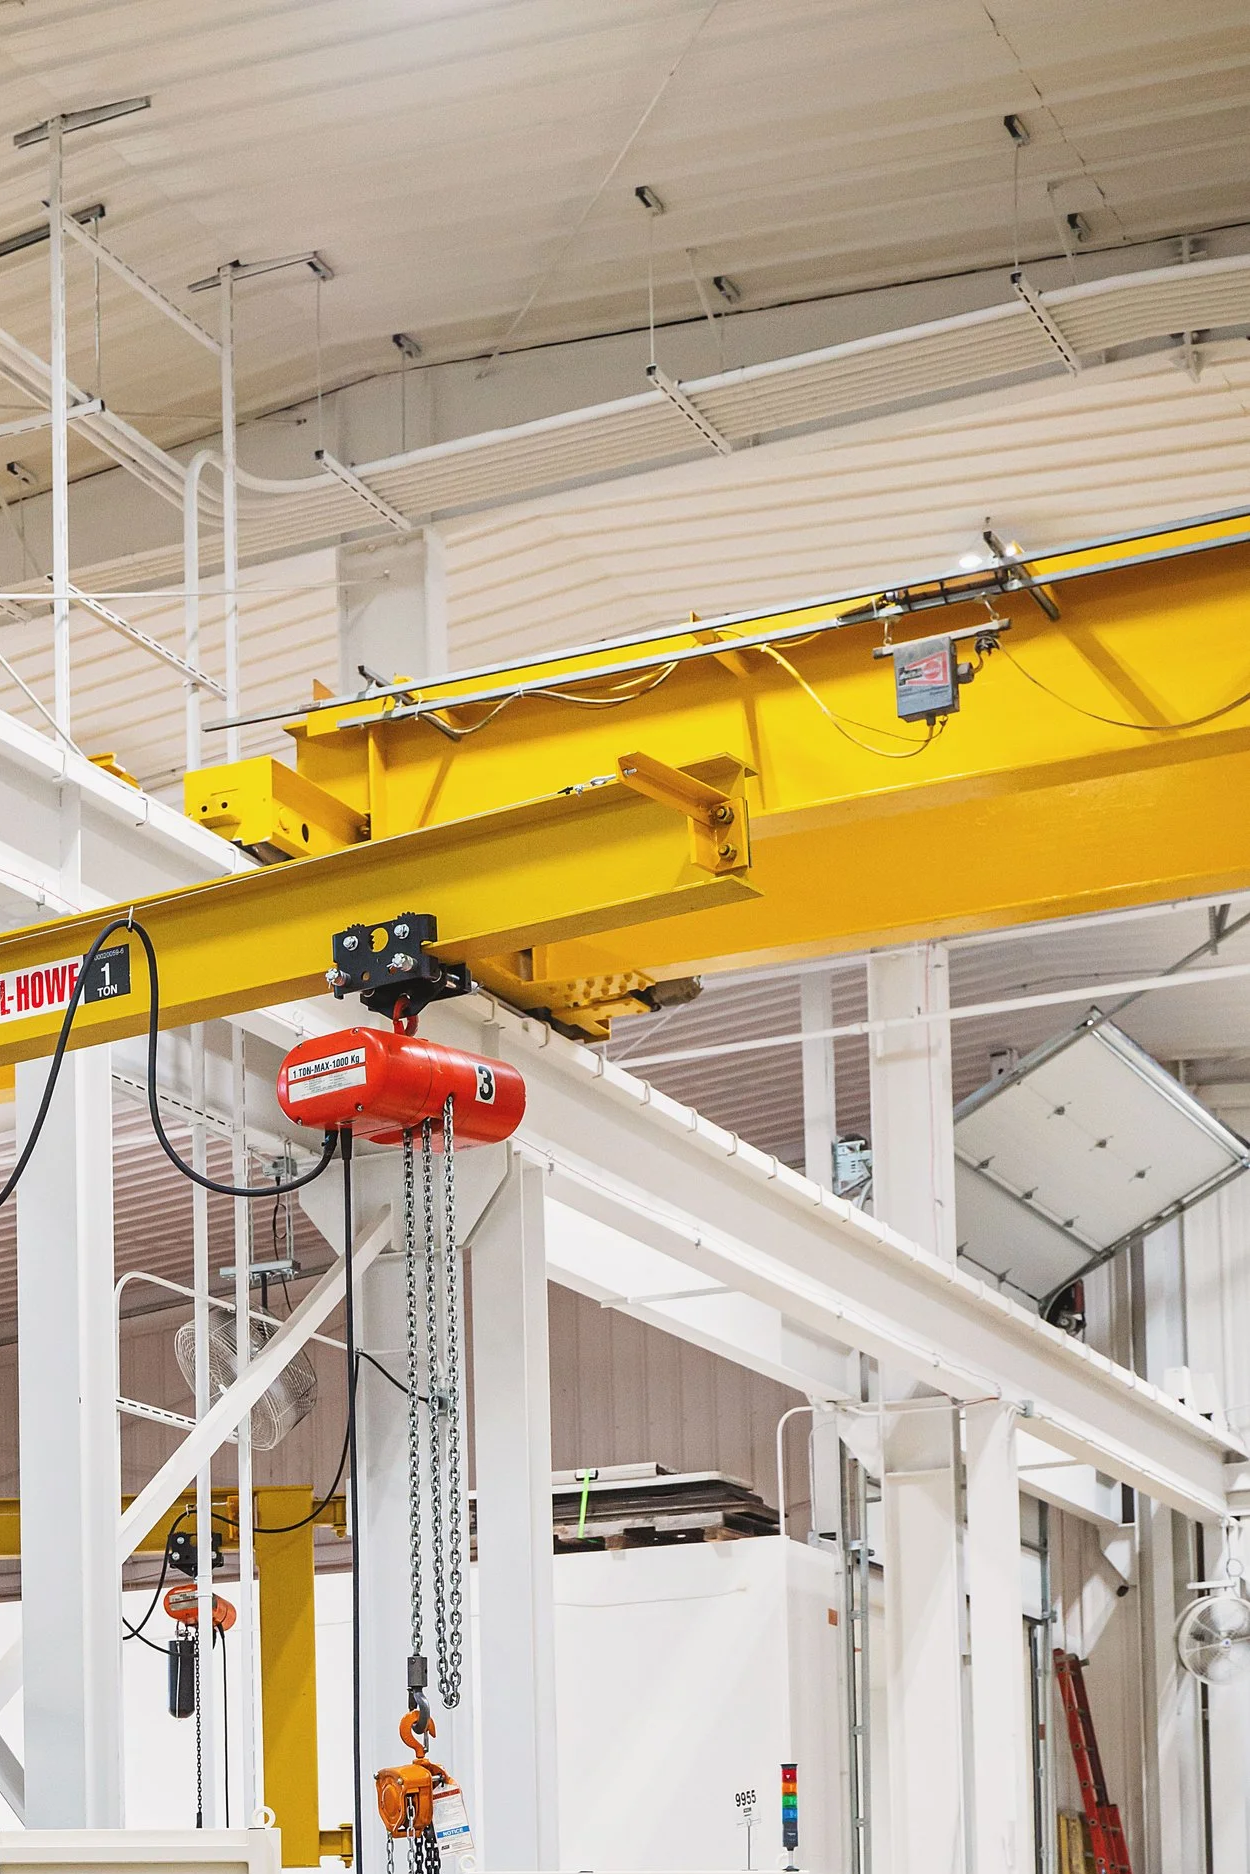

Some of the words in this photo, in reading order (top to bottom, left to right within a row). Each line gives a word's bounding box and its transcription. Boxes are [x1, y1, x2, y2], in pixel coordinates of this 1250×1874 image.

[101, 963, 110, 986] 1
[97, 984, 118, 998] TON
[351, 1055, 360, 1065] Kg
[478, 1065, 494, 1101] 3
[735, 1789, 757, 1807] 9955
[442, 1827, 464, 1837] NOTICE
